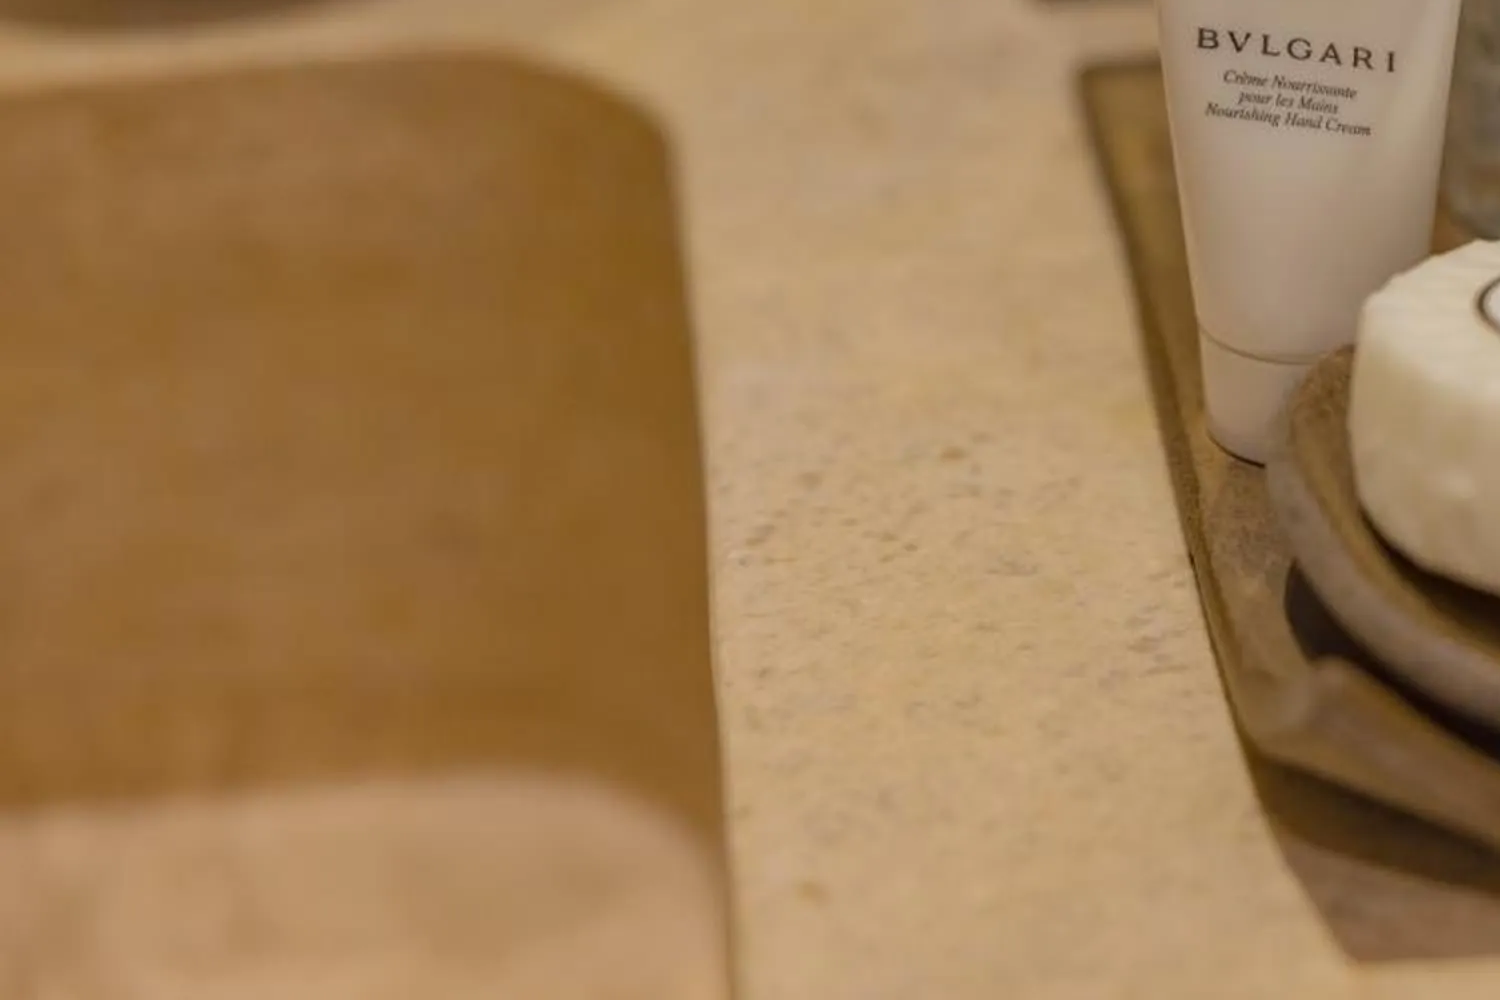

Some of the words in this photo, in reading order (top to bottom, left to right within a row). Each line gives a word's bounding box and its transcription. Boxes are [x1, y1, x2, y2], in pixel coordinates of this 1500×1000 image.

[1197, 27, 1396, 73] BVLGARI
[1223, 69, 1268, 88] Crème
[1204, 101, 1281, 127] Nourishing
[1284, 111, 1322, 131] Hand
[1238, 90, 1273, 105] pour
[1275, 93, 1295, 108] les
[1298, 96, 1339, 115] Mains
